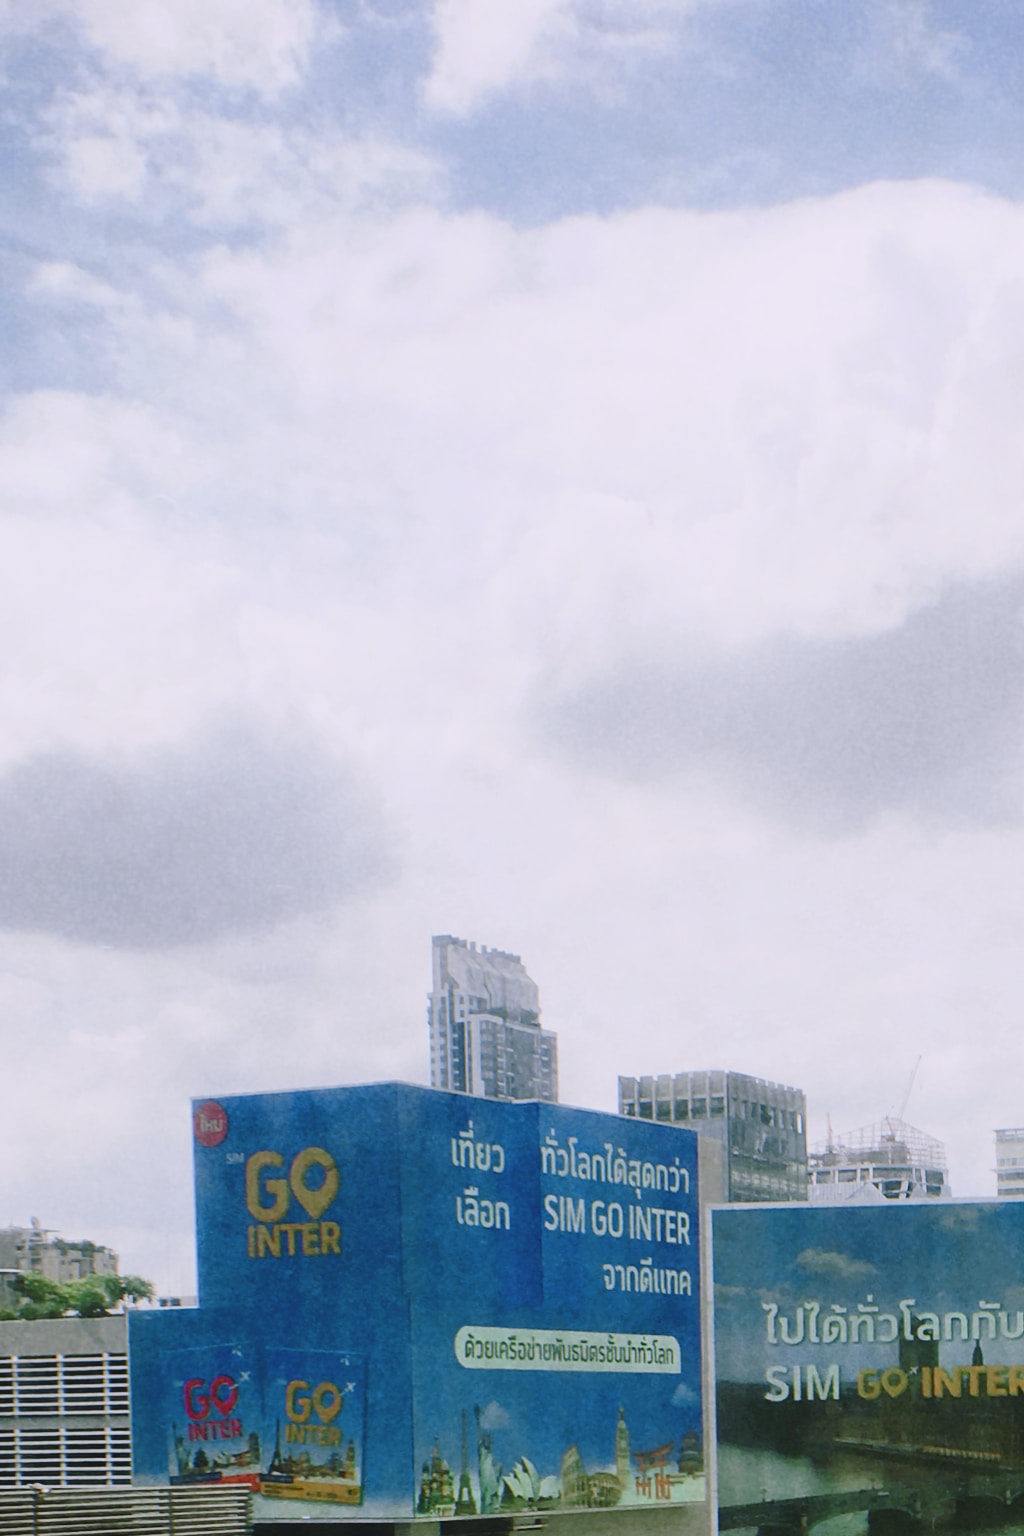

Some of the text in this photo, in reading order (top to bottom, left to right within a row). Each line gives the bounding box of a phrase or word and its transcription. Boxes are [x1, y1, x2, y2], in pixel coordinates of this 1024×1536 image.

[451, 1120, 505, 1174] เที่ยว
[245, 1146, 340, 1223] GO
[456, 1185, 691, 1246] เลือก SIM GO INTER
[247, 1221, 342, 1258] INTER
[603, 1257, 692, 1297] จากดีแทค
[183, 1375, 239, 1422] GO
[285, 1379, 343, 1425] GO
[764, 1363, 841, 1402] SIM
[857, 1367, 909, 1399] GO
[187, 1418, 243, 1442] INTER
[284, 1423, 342, 1447] INTER
